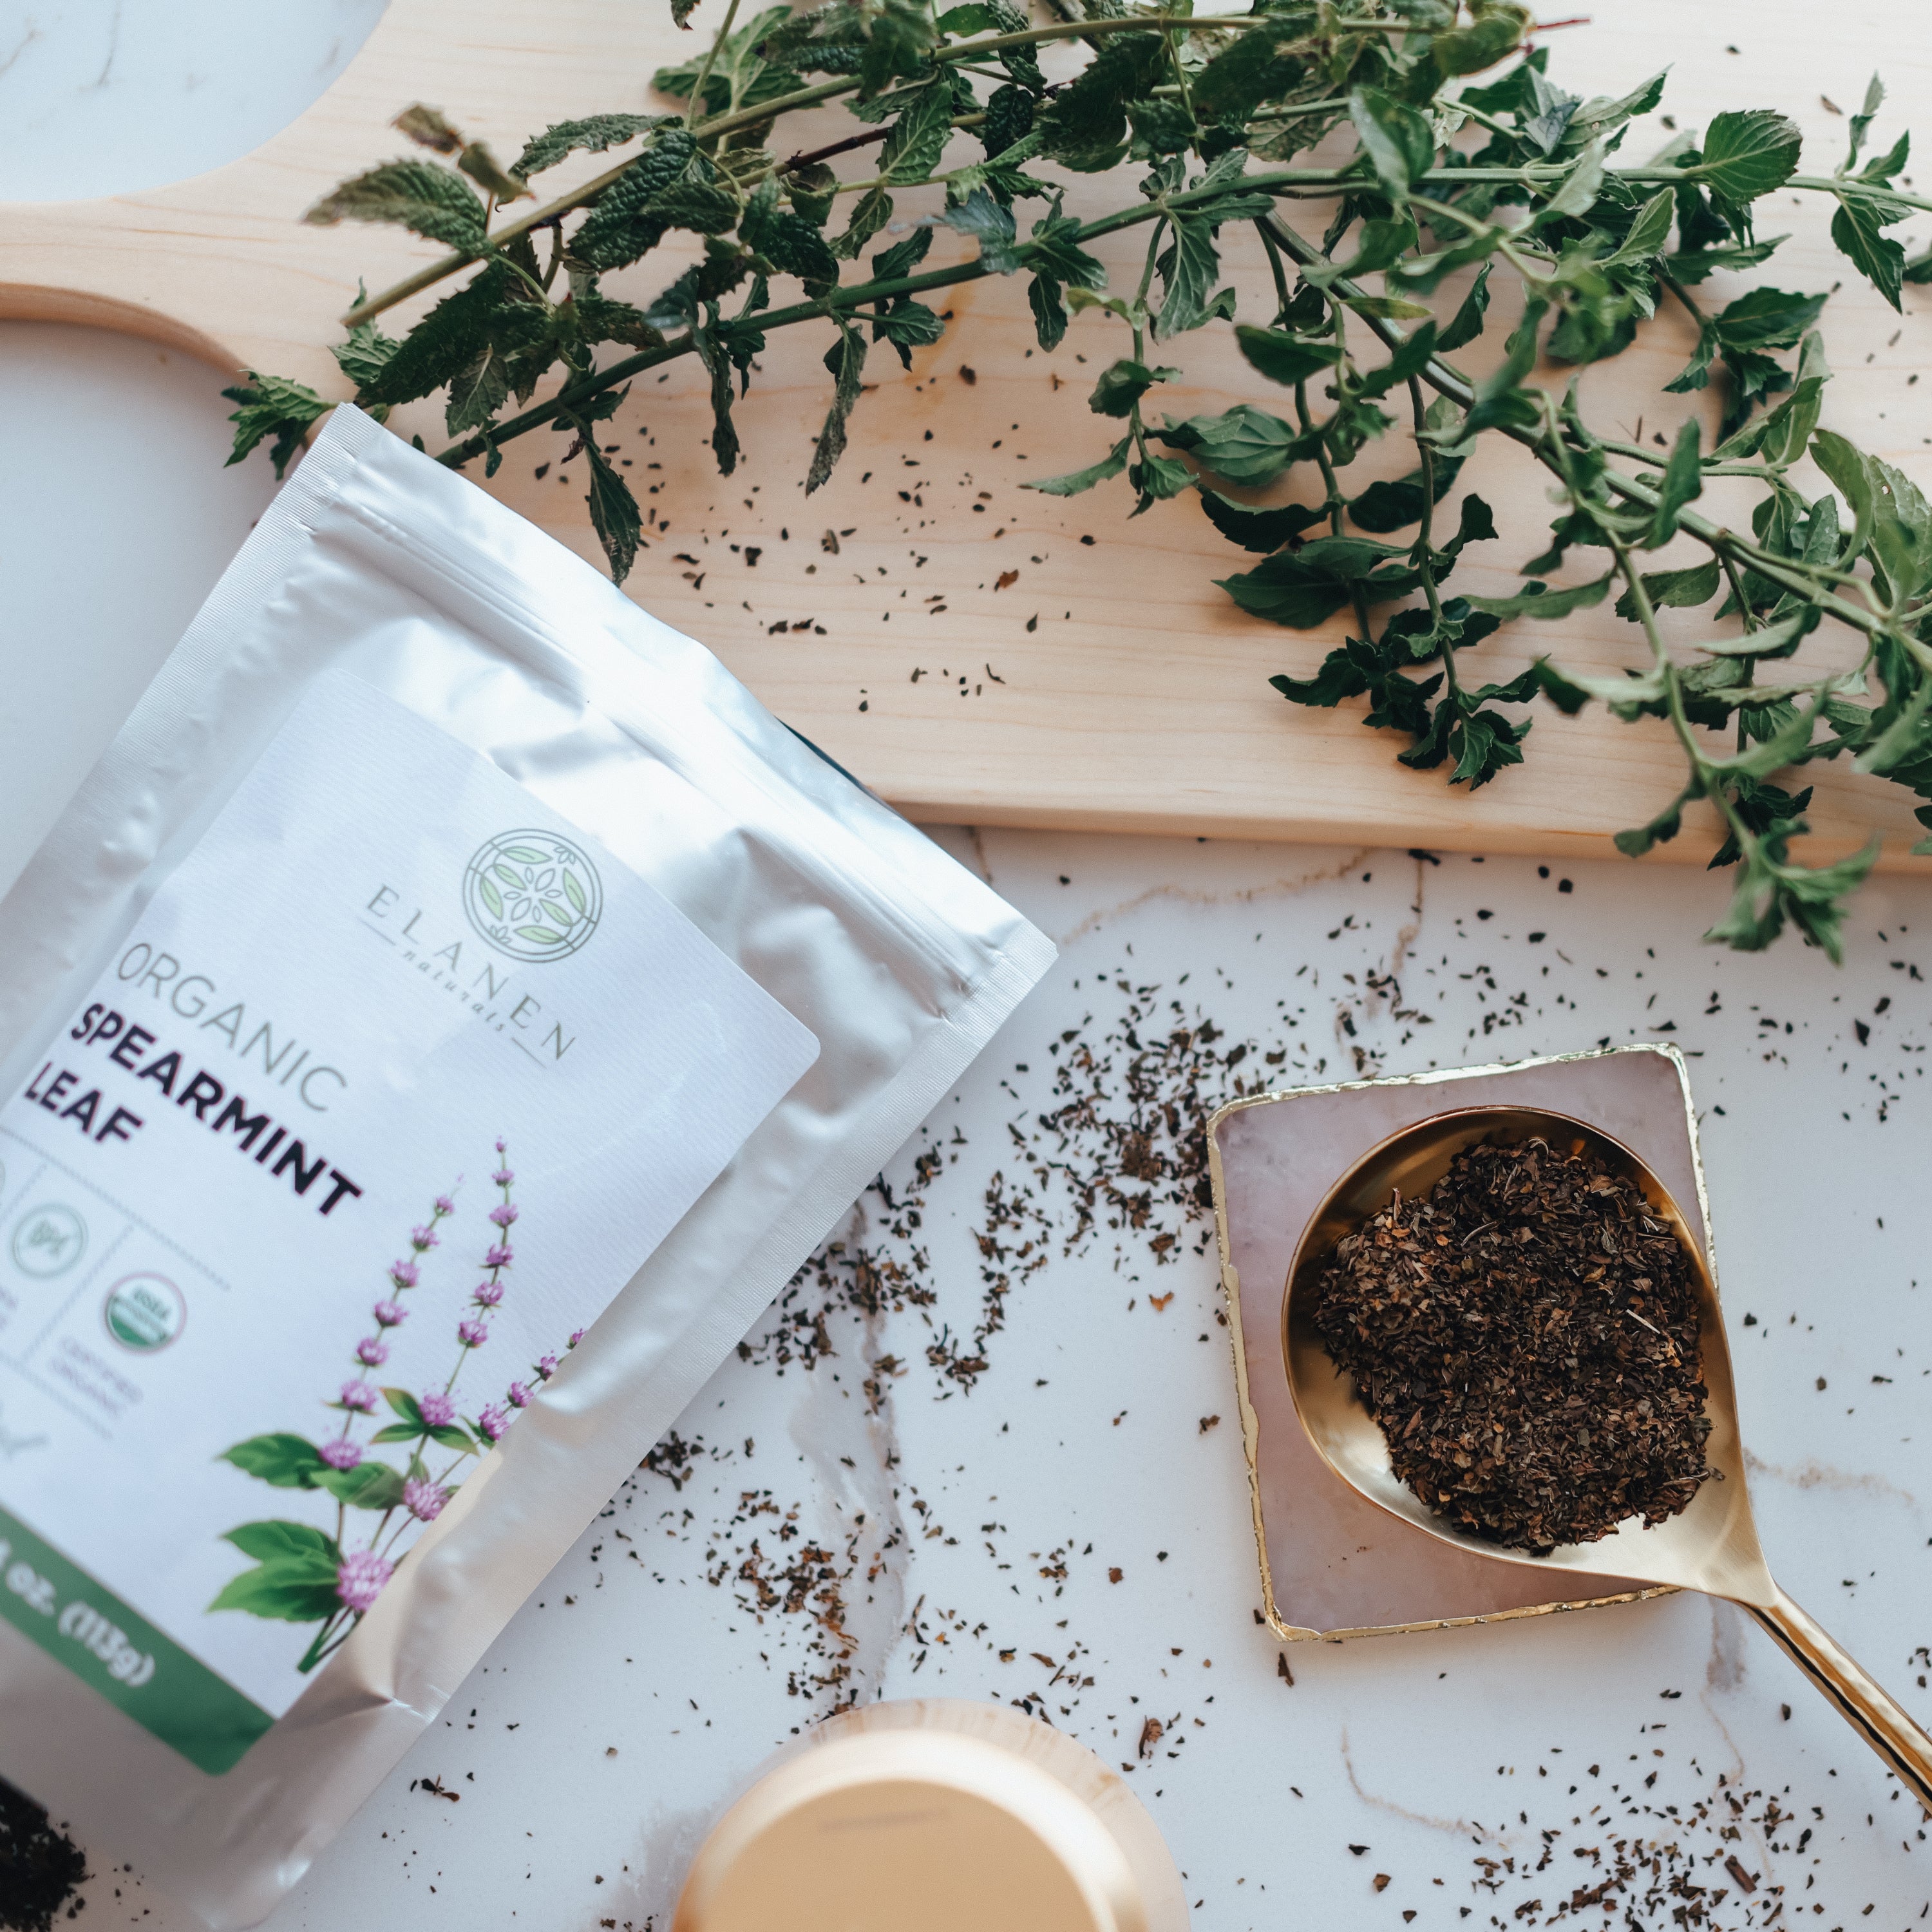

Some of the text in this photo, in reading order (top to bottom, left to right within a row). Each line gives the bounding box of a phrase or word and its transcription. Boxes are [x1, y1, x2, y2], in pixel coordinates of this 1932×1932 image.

[118, 942, 348, 1112] ORGANIC
[366, 884, 576, 1061] ELANEN
[402, 950, 507, 1032] naturals
[24, 1061, 145, 1144] LEAF
[71, 1002, 364, 1217] SPEARMINT
